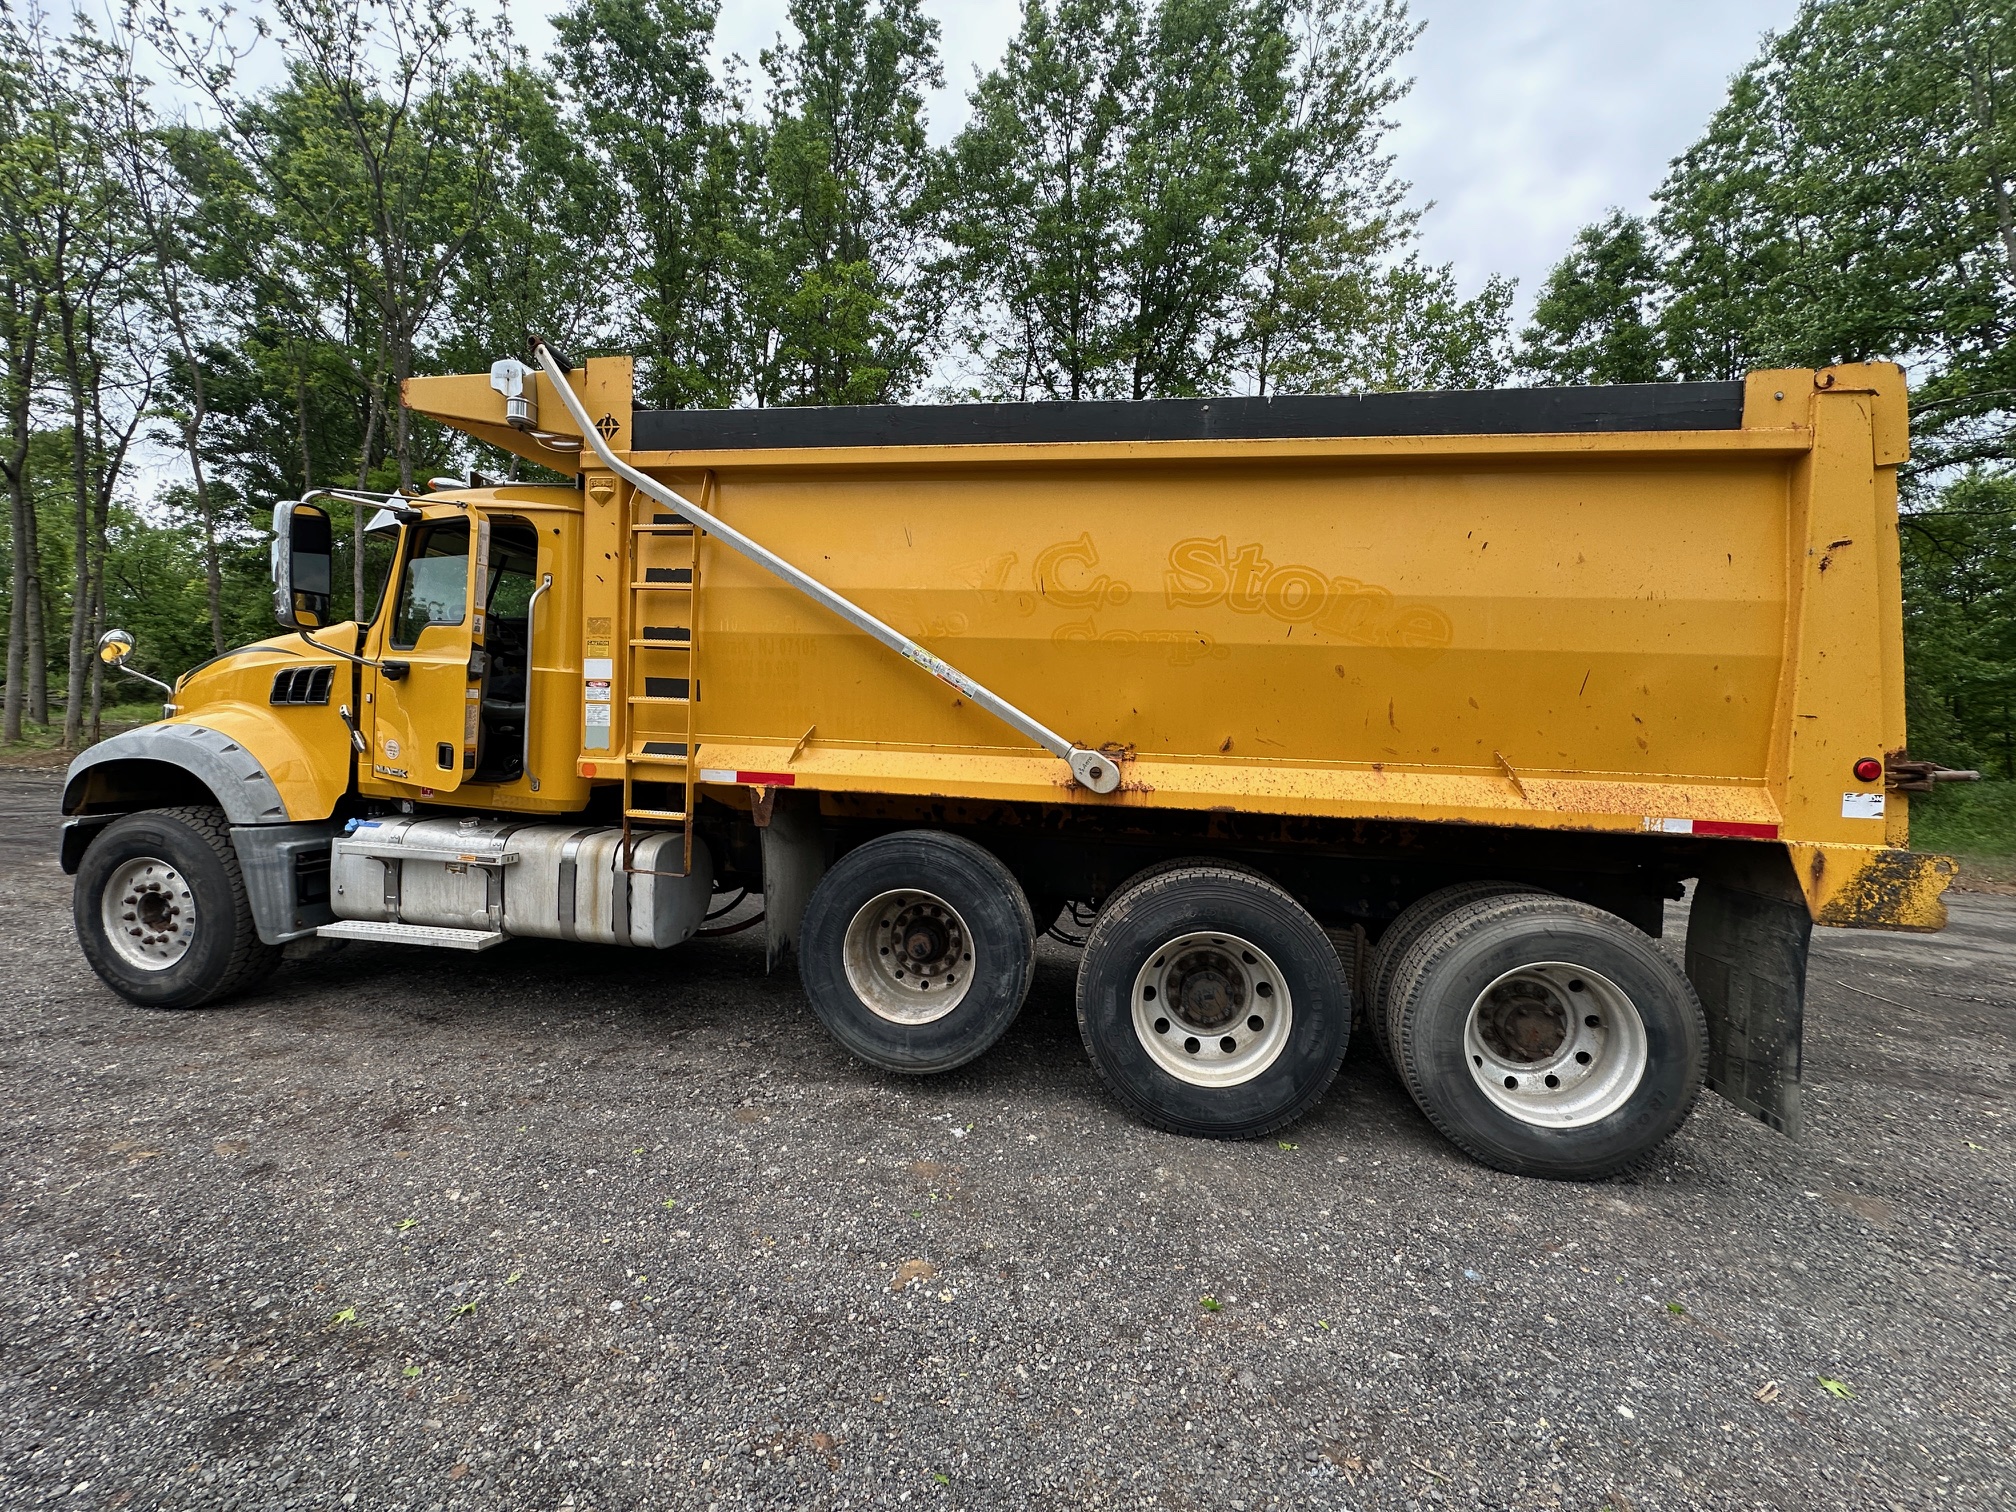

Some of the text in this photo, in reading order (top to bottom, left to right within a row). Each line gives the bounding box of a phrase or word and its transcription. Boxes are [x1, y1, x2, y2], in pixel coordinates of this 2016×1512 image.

[1162, 535, 1453, 662] Stone
[1052, 616, 1232, 666] Corp.
[375, 764, 408, 779] MACK
